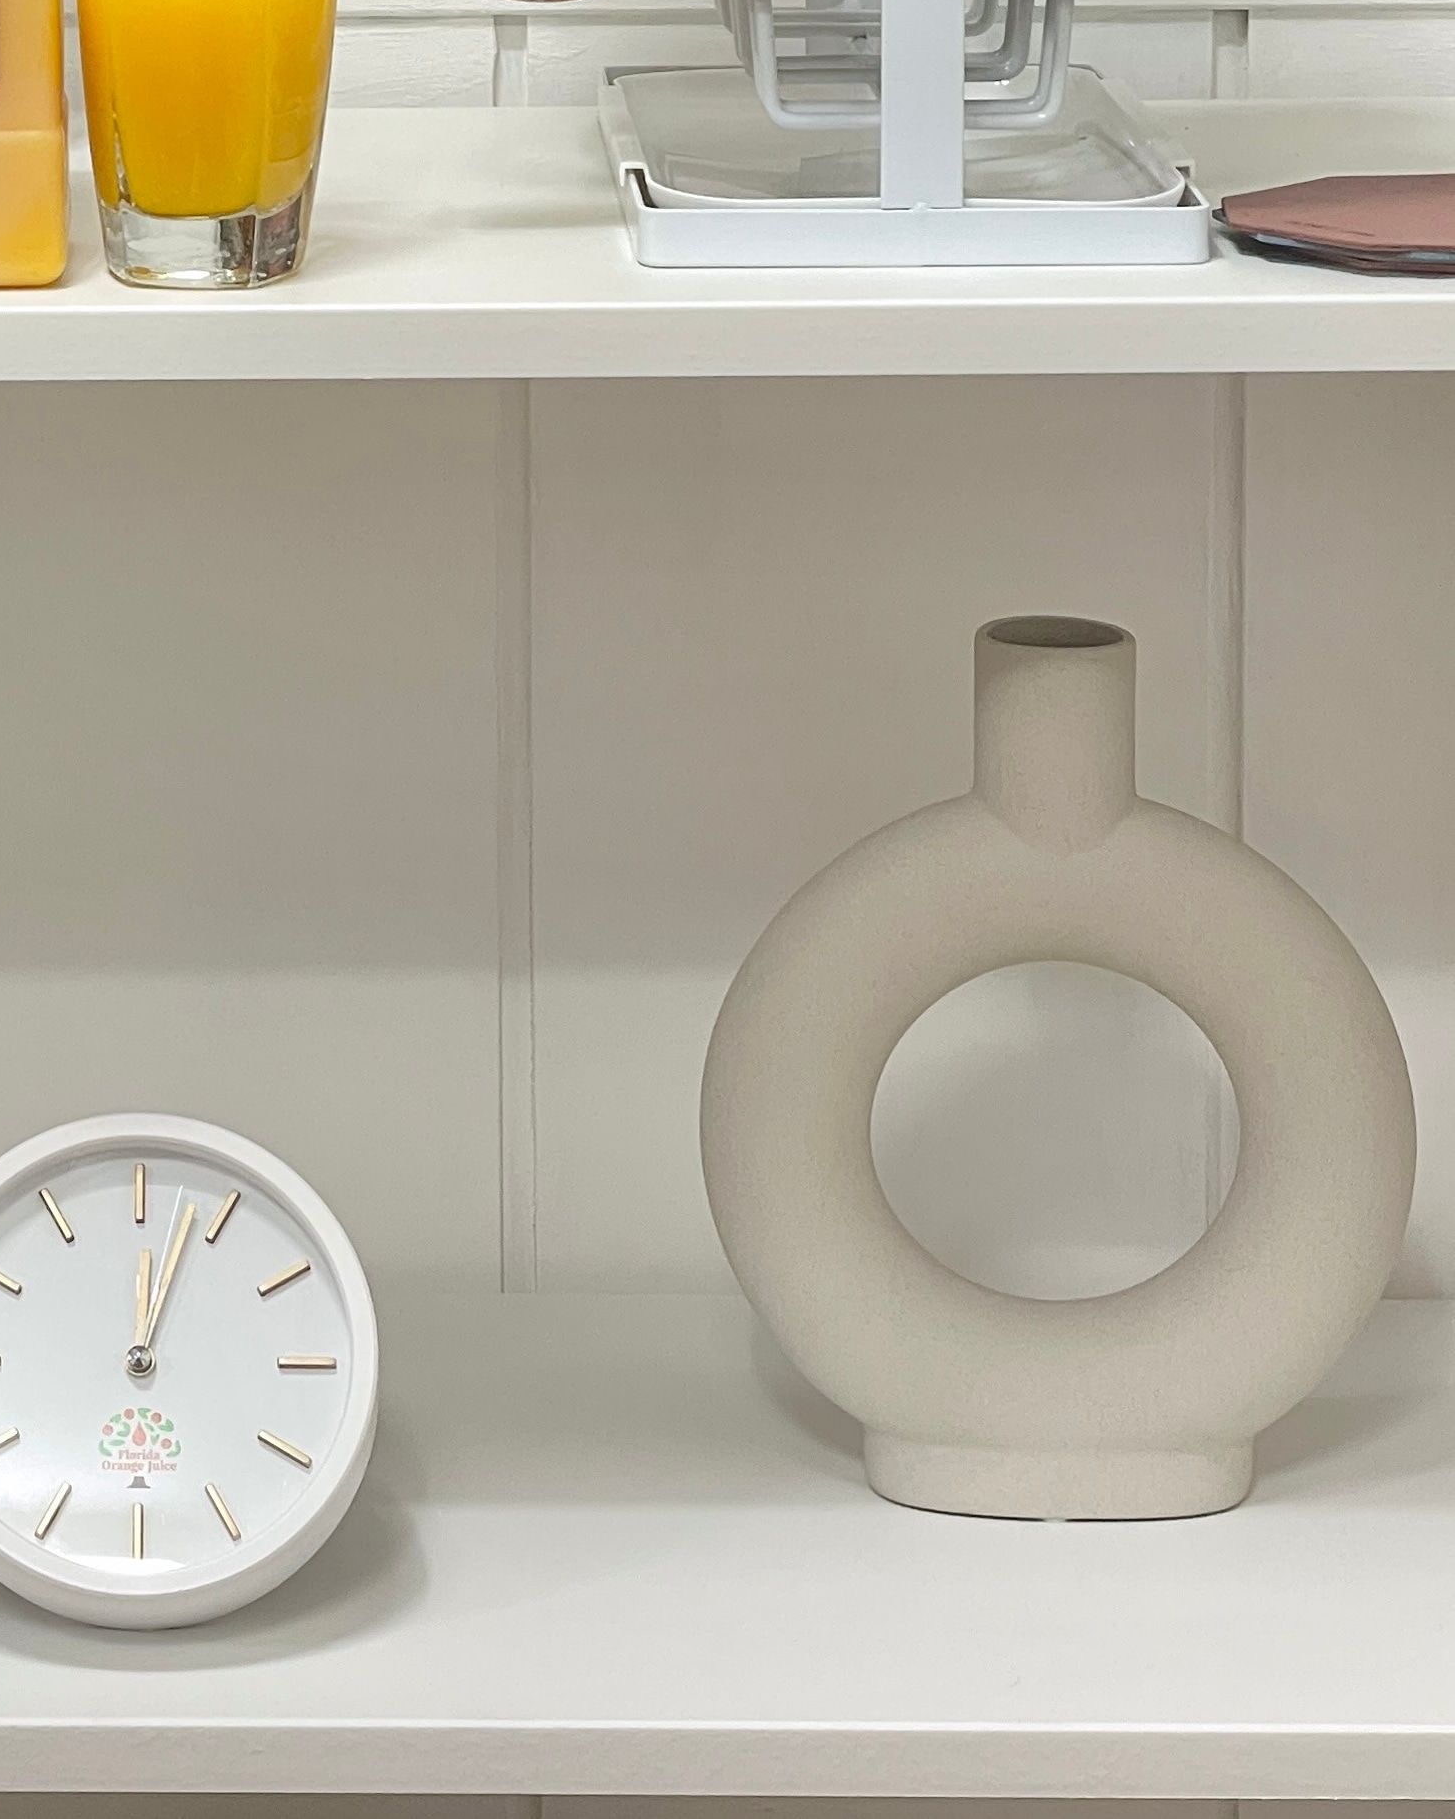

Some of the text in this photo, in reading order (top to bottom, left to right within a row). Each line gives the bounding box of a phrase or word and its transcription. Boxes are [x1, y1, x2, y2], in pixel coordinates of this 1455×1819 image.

[118, 1449, 160, 1460] Florida
[102, 1460, 177, 1473] Orange Juice
